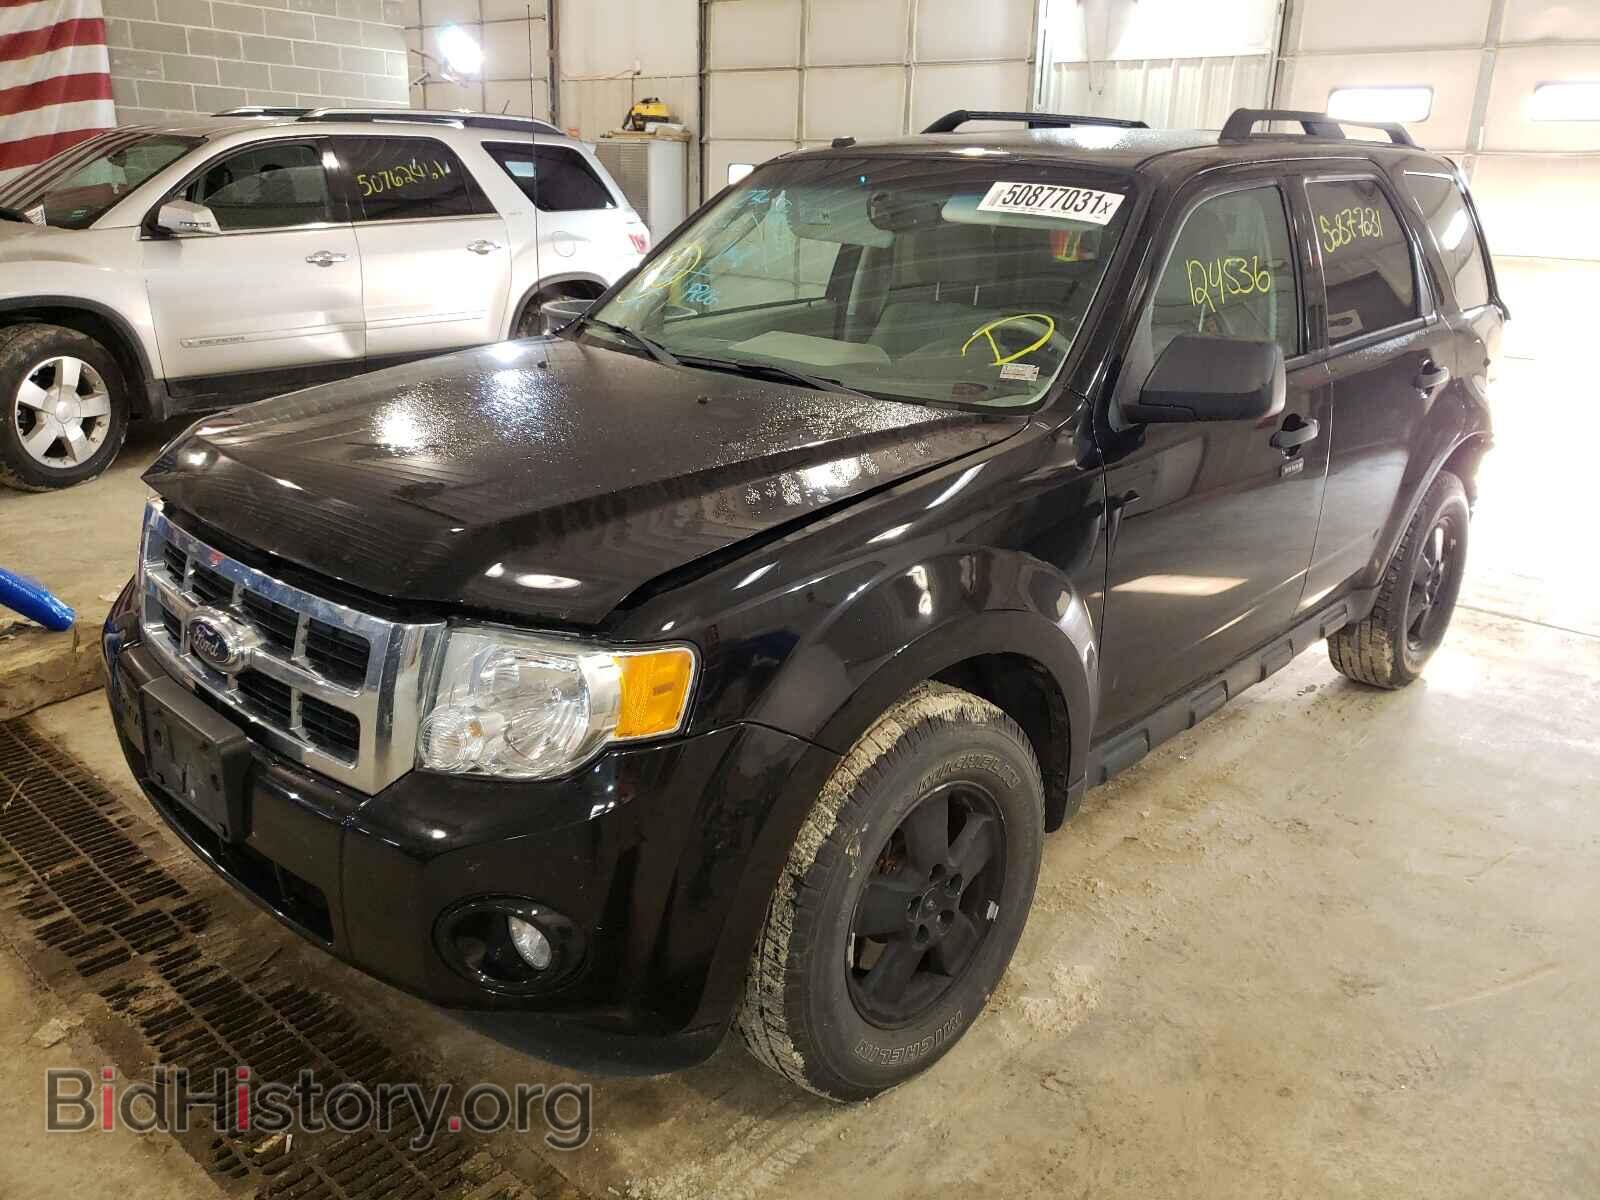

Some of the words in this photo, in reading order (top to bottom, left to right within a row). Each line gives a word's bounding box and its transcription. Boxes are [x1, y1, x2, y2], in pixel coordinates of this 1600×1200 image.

[1186, 255, 1272, 313] 124536
[194, 624, 220, 657] Ford
[854, 1009, 962, 1066] MICHELIN
